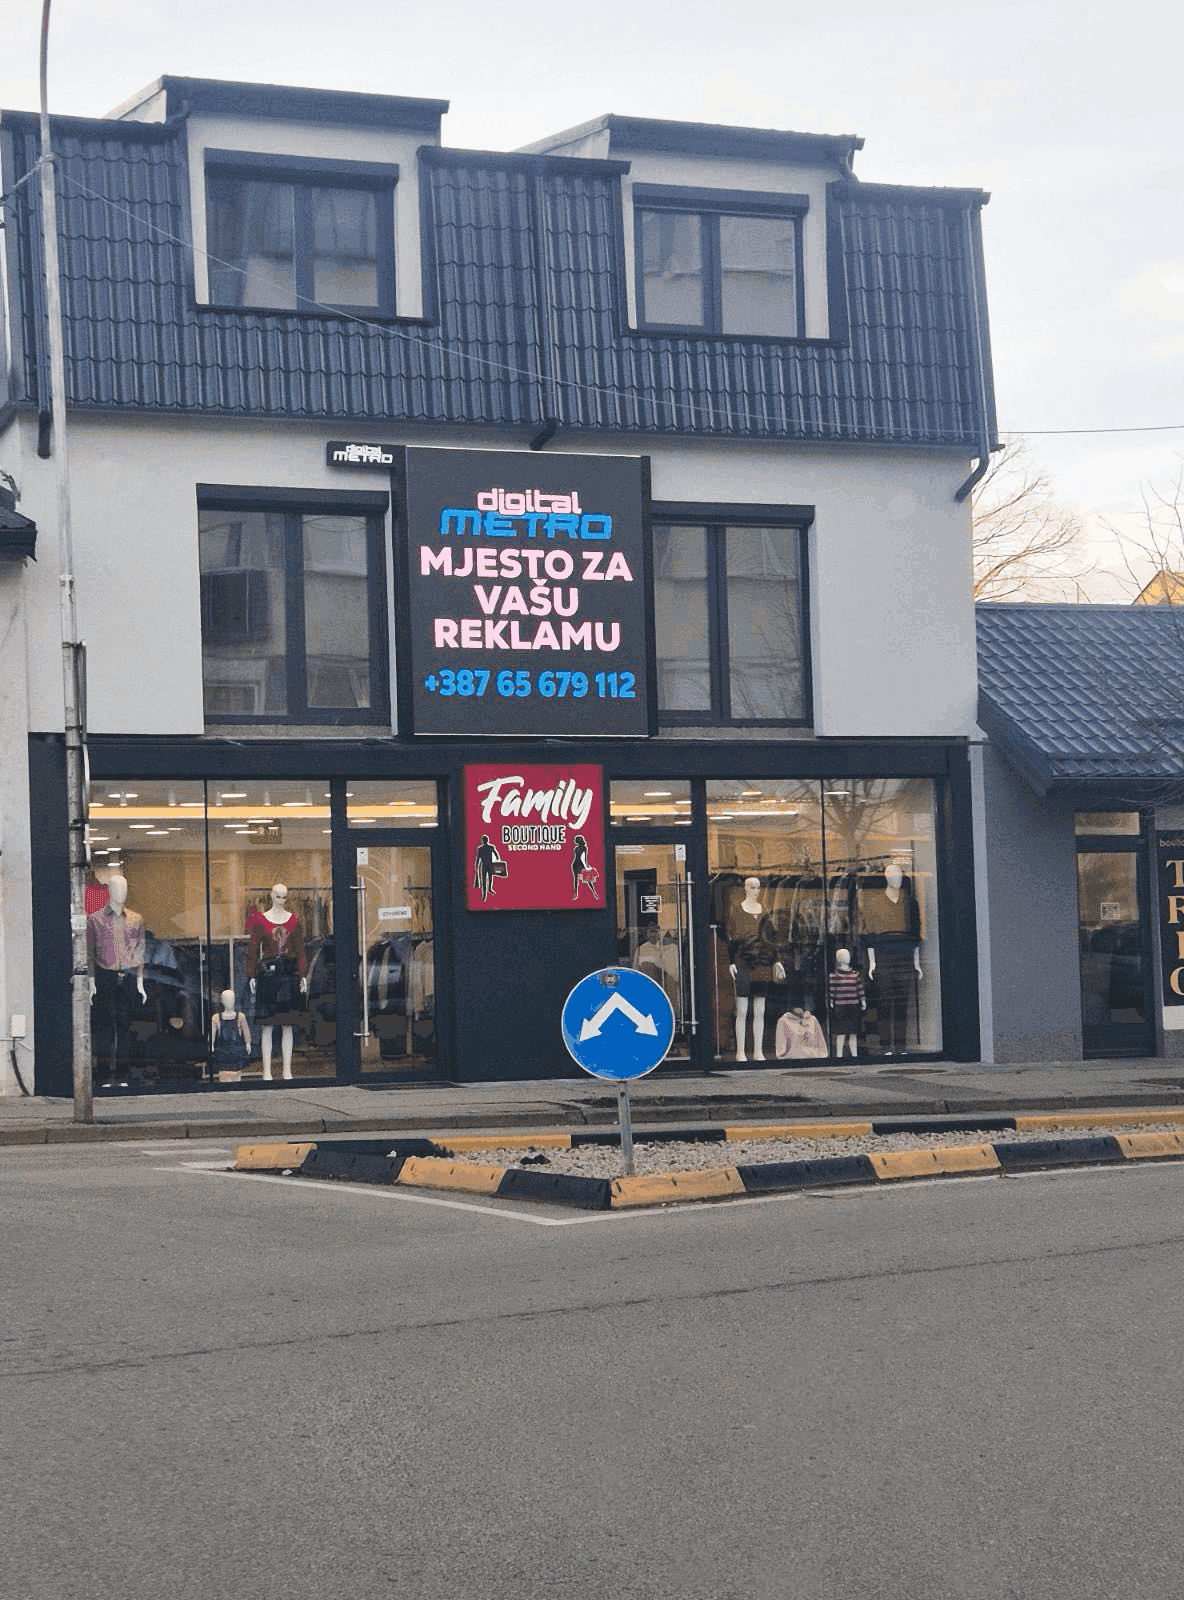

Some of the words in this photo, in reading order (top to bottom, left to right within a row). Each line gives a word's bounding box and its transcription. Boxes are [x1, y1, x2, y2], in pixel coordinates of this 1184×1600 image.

[333, 450, 393, 464] METRO
[478, 488, 582, 515] digital
[439, 507, 613, 540] METRO
[420, 546, 574, 580] MJESTO
[582, 551, 634, 582] ZA
[473, 579, 579, 617] VAŠU
[434, 618, 621, 652] REKLAMU
[424, 668, 491, 697] +387
[496, 670, 532, 698] 65
[537, 670, 589, 698] 679
[594, 671, 636, 698] 112
[477, 775, 594, 830] Family
[502, 825, 567, 844] BOUTIQUE
